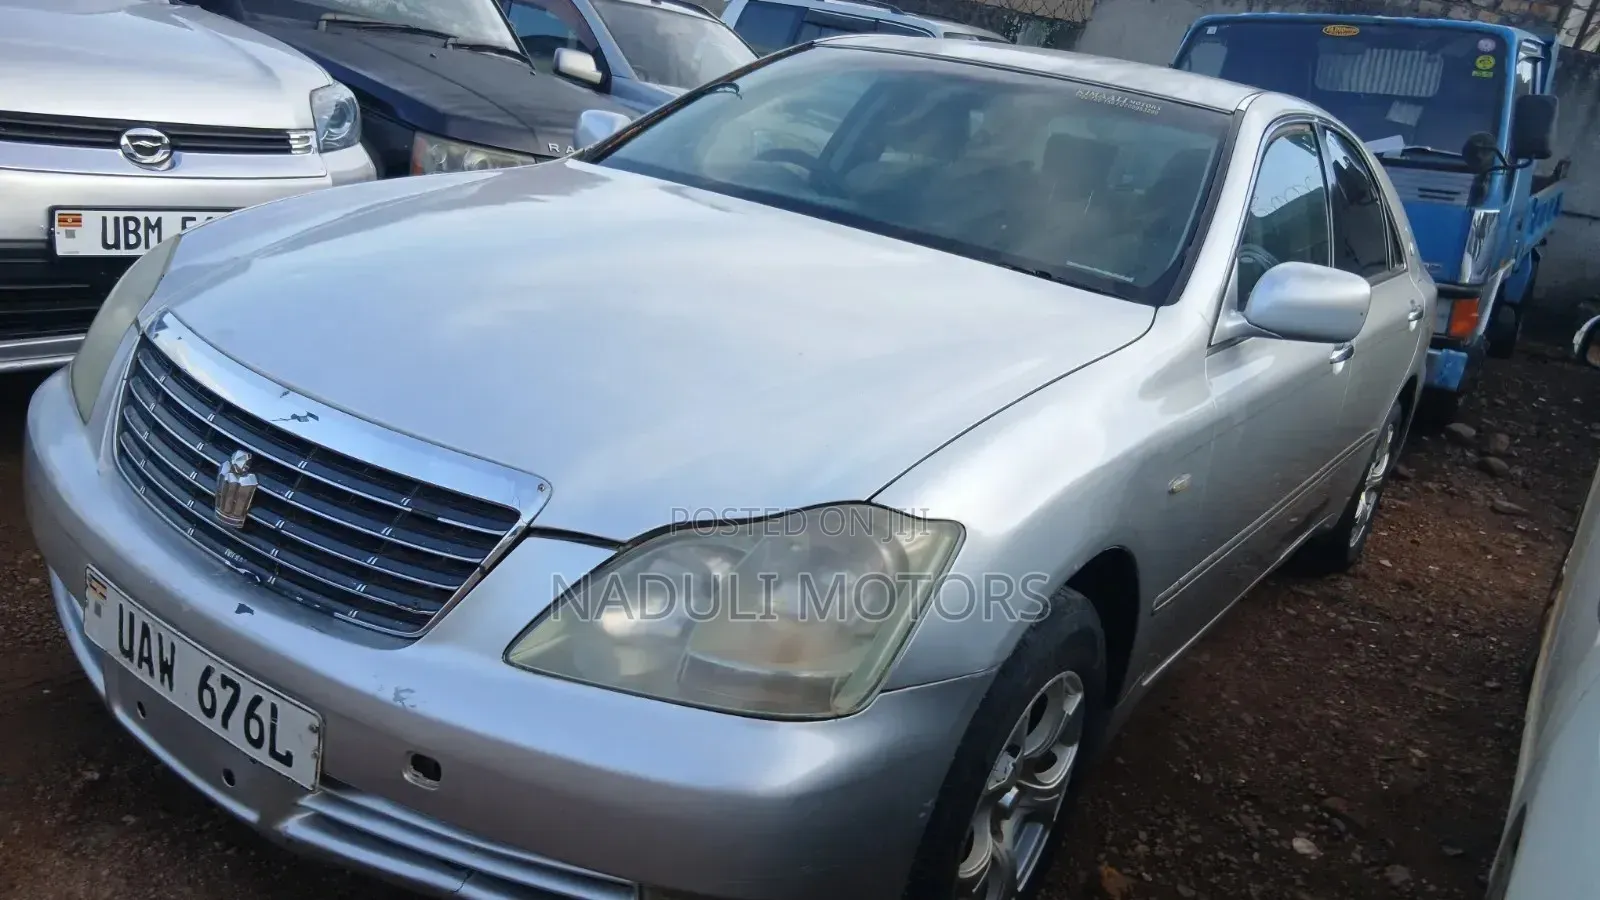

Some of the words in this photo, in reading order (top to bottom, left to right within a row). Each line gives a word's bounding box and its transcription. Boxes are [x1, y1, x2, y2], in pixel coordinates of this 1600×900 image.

[101, 215, 163, 251] UBM
[118, 602, 176, 692] UAW
[197, 664, 293, 768] 676L
